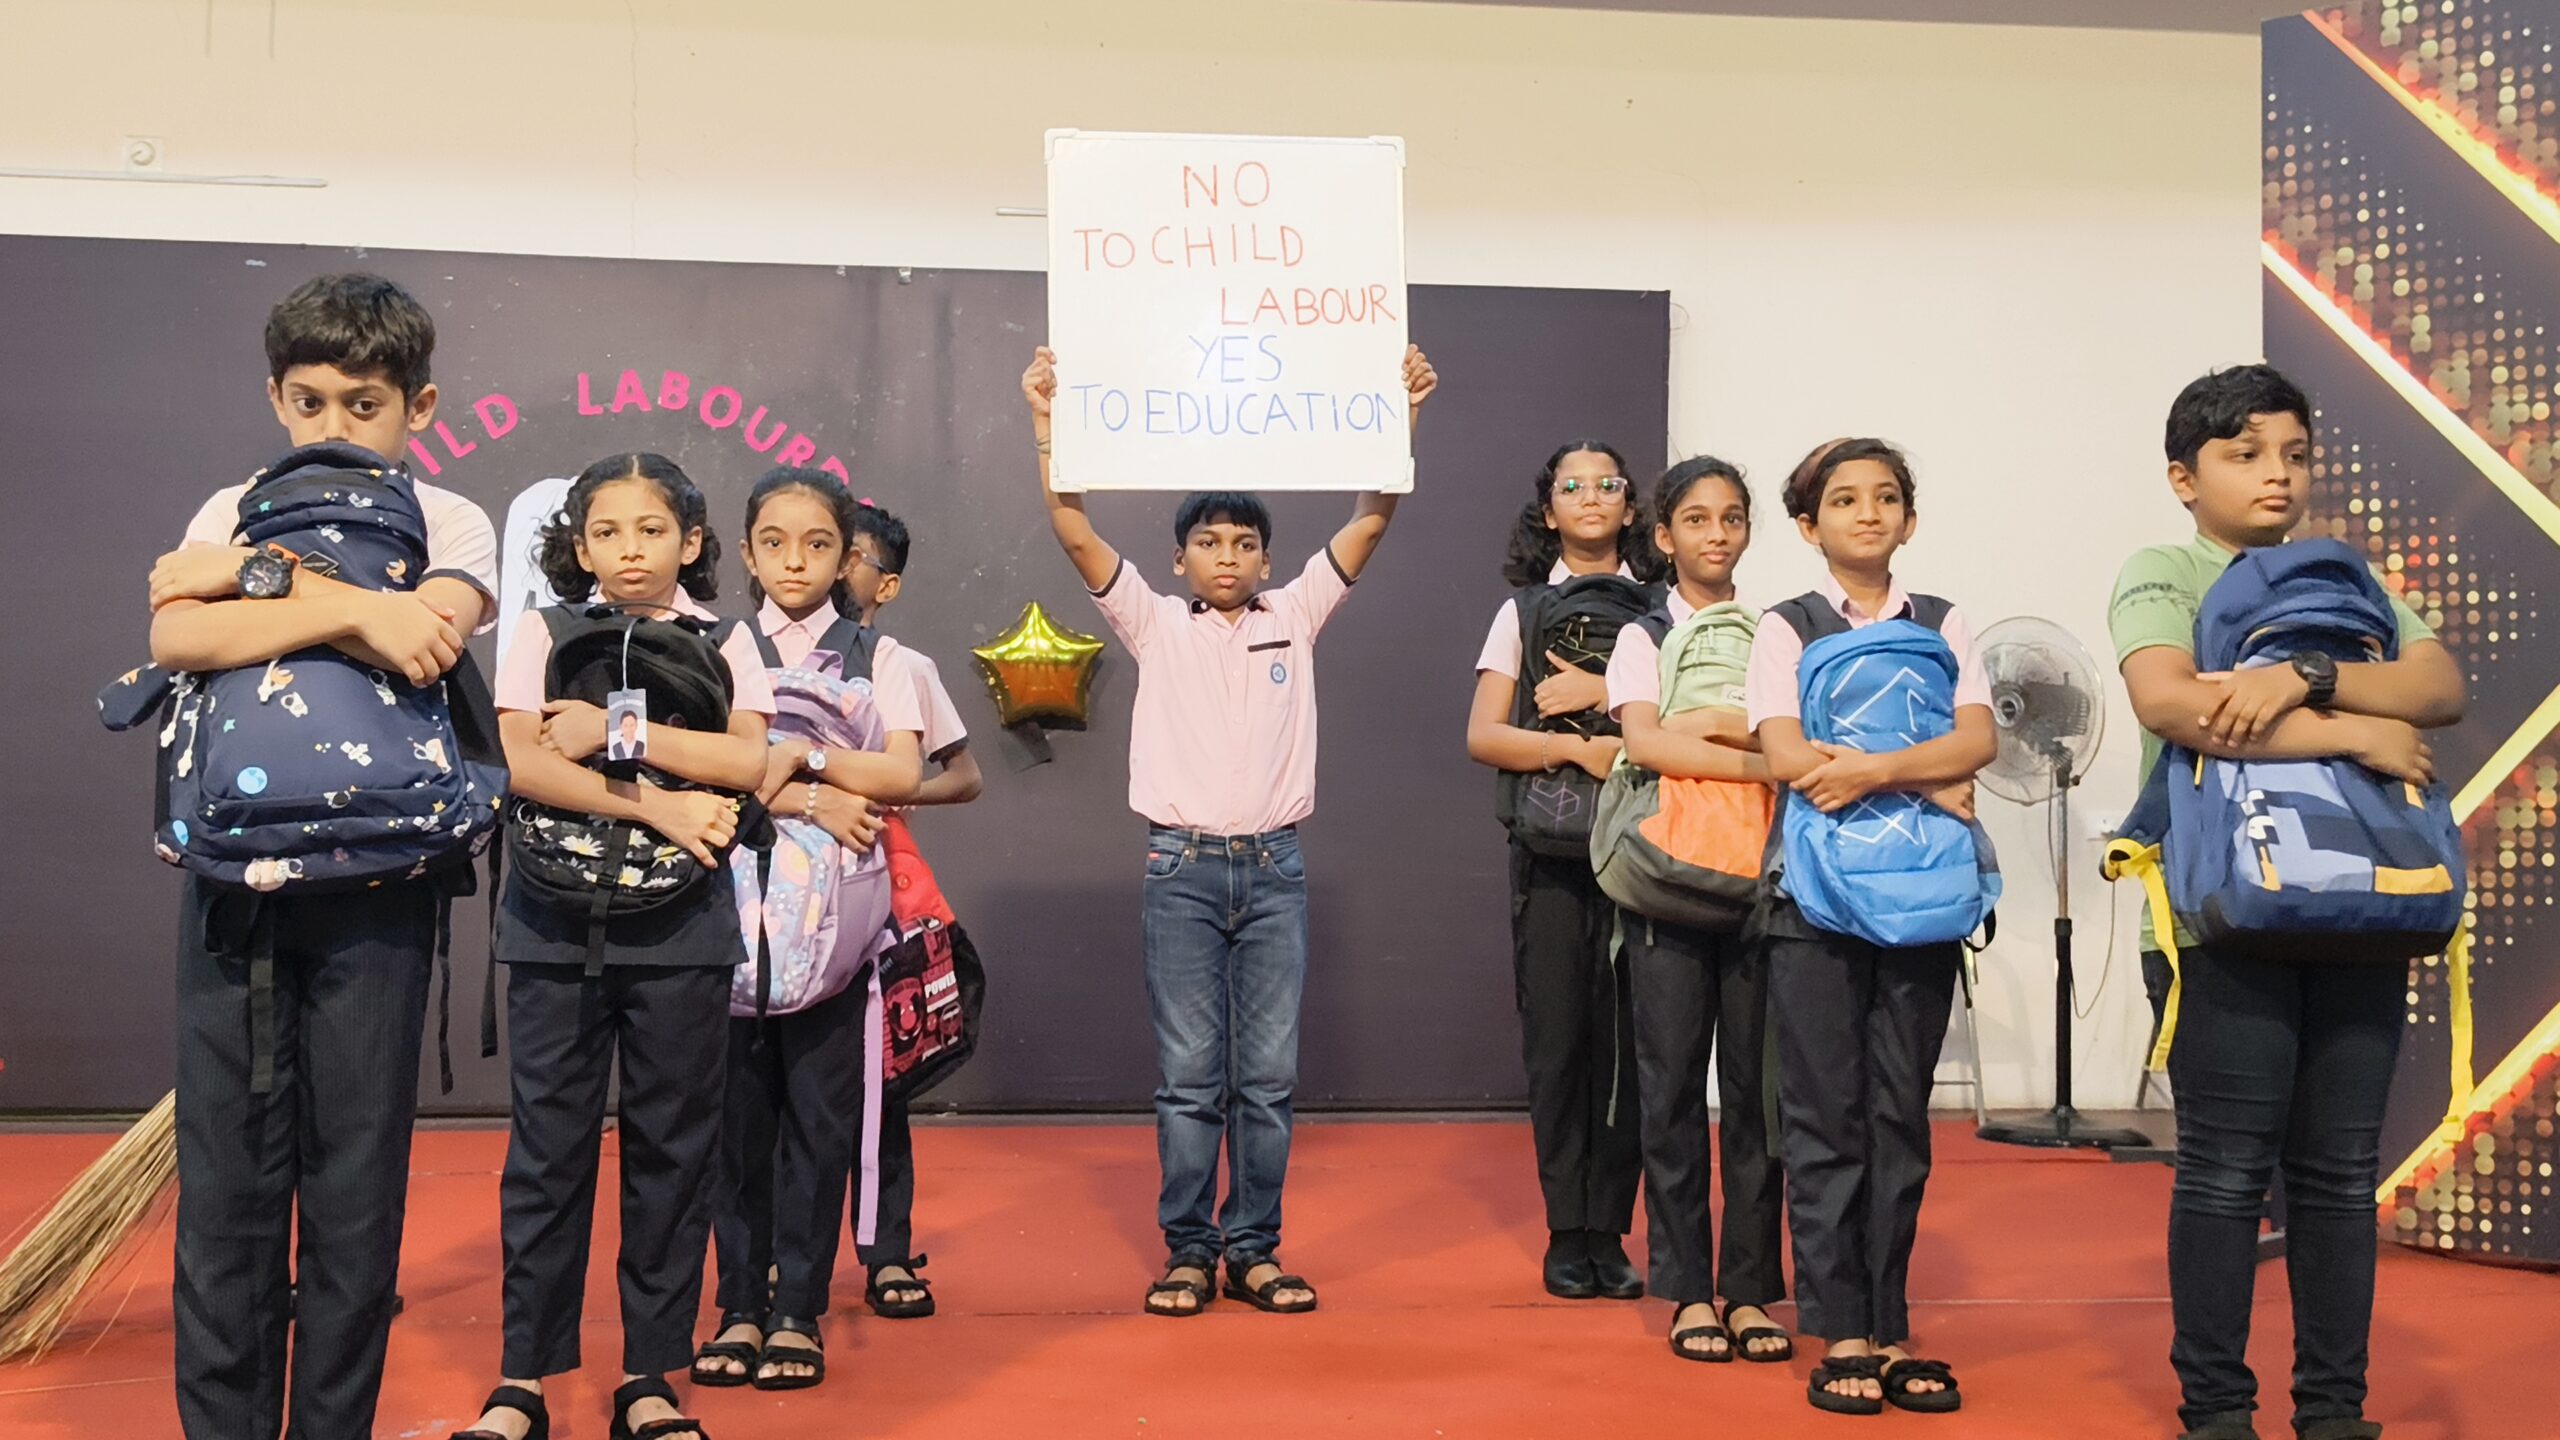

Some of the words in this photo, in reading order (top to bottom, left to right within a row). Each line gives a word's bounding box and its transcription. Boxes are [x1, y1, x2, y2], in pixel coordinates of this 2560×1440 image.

[1183, 161, 1270, 208] NO
[1073, 228, 1135, 271] TO
[1151, 223, 1304, 268] CHILD
[1220, 284, 1397, 326] LABOUR
[1188, 334, 1282, 383] YES
[407, 392, 518, 475] ILD
[1070, 384, 1130, 431] TO
[1145, 389, 1397, 435] EDUCATION
